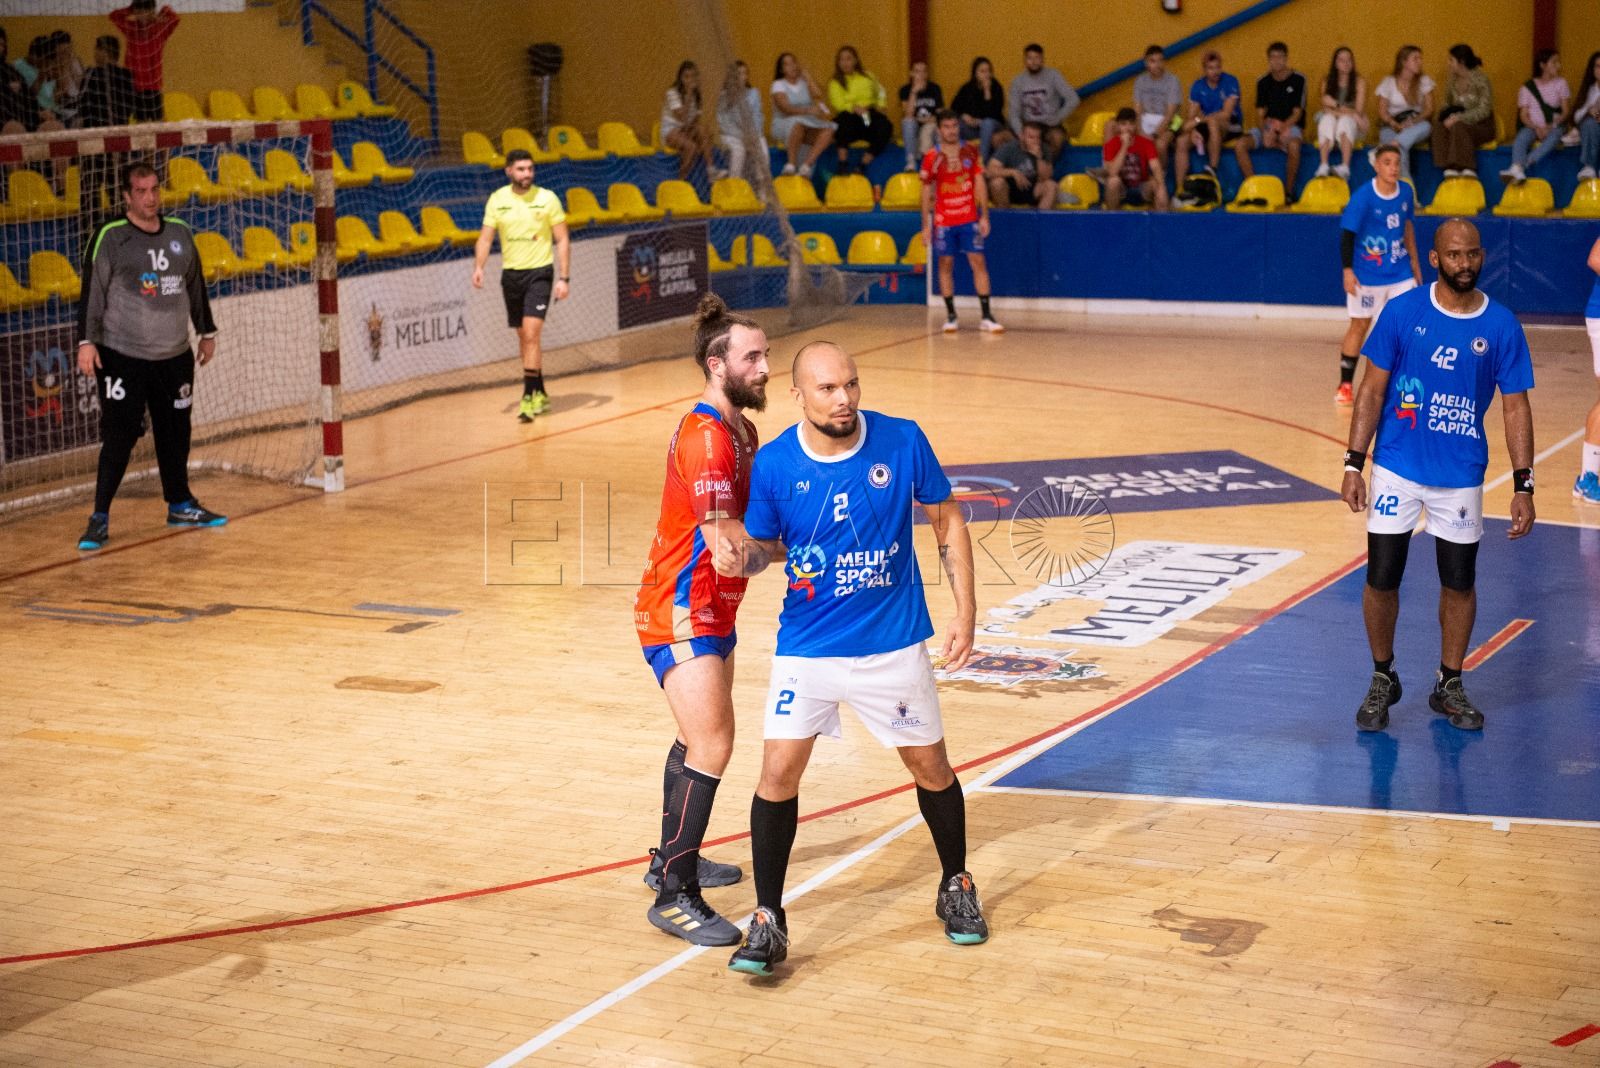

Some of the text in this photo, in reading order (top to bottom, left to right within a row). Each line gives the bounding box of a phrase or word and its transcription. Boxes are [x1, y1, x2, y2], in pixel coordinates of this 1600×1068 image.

[147, 248, 170, 271] 16
[395, 315, 468, 350] MELILLA
[1430, 345, 1458, 371] 42
[104, 376, 126, 400] 16
[1431, 392, 1476, 413] MELILL
[1428, 418, 1480, 439] CAPITA
[1043, 465, 1257, 486] MELILLA
[833, 492, 849, 523] 2
[1374, 494, 1399, 516] 42
[1050, 552, 1280, 640] MELILLA
[775, 689, 796, 716] 2
